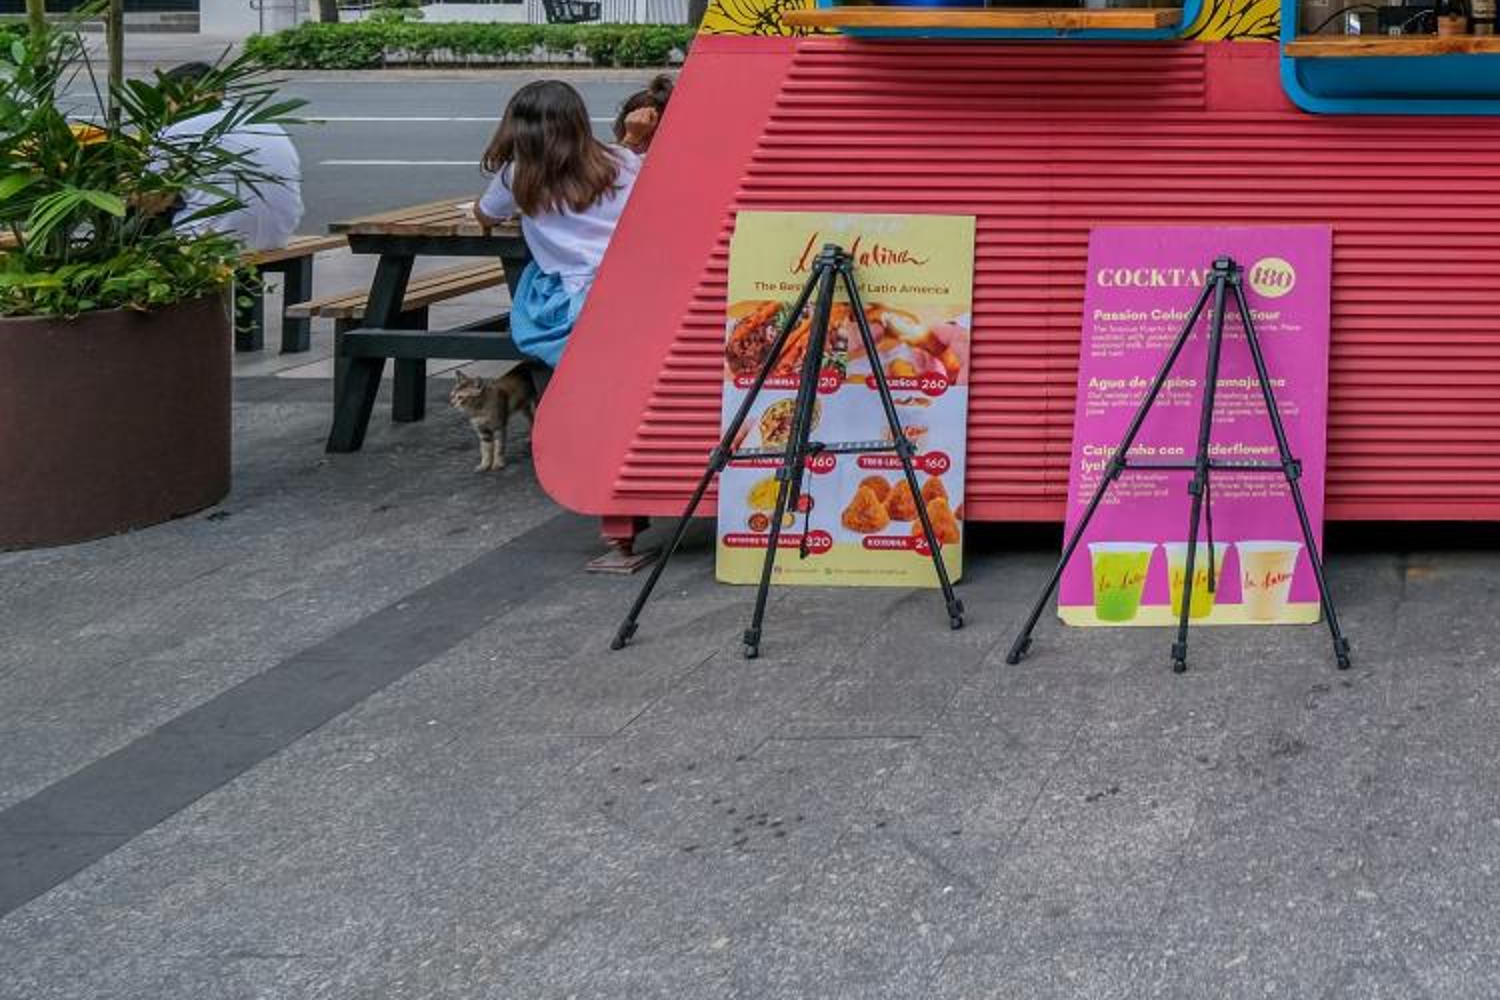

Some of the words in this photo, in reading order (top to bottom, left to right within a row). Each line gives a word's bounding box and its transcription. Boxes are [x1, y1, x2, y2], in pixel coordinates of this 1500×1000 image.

[1253, 267, 1293, 289] 180
[755, 281, 776, 292] The
[780, 282, 800, 292] Bes
[867, 282, 897, 293] Latin
[899, 284, 949, 295] America
[1093, 309, 1148, 321] Passion
[1152, 308, 1196, 321] Colad
[921, 378, 947, 390] 260
[1088, 377, 1125, 391] Agua
[1129, 376, 1147, 387] de
[805, 537, 831, 547] 320
